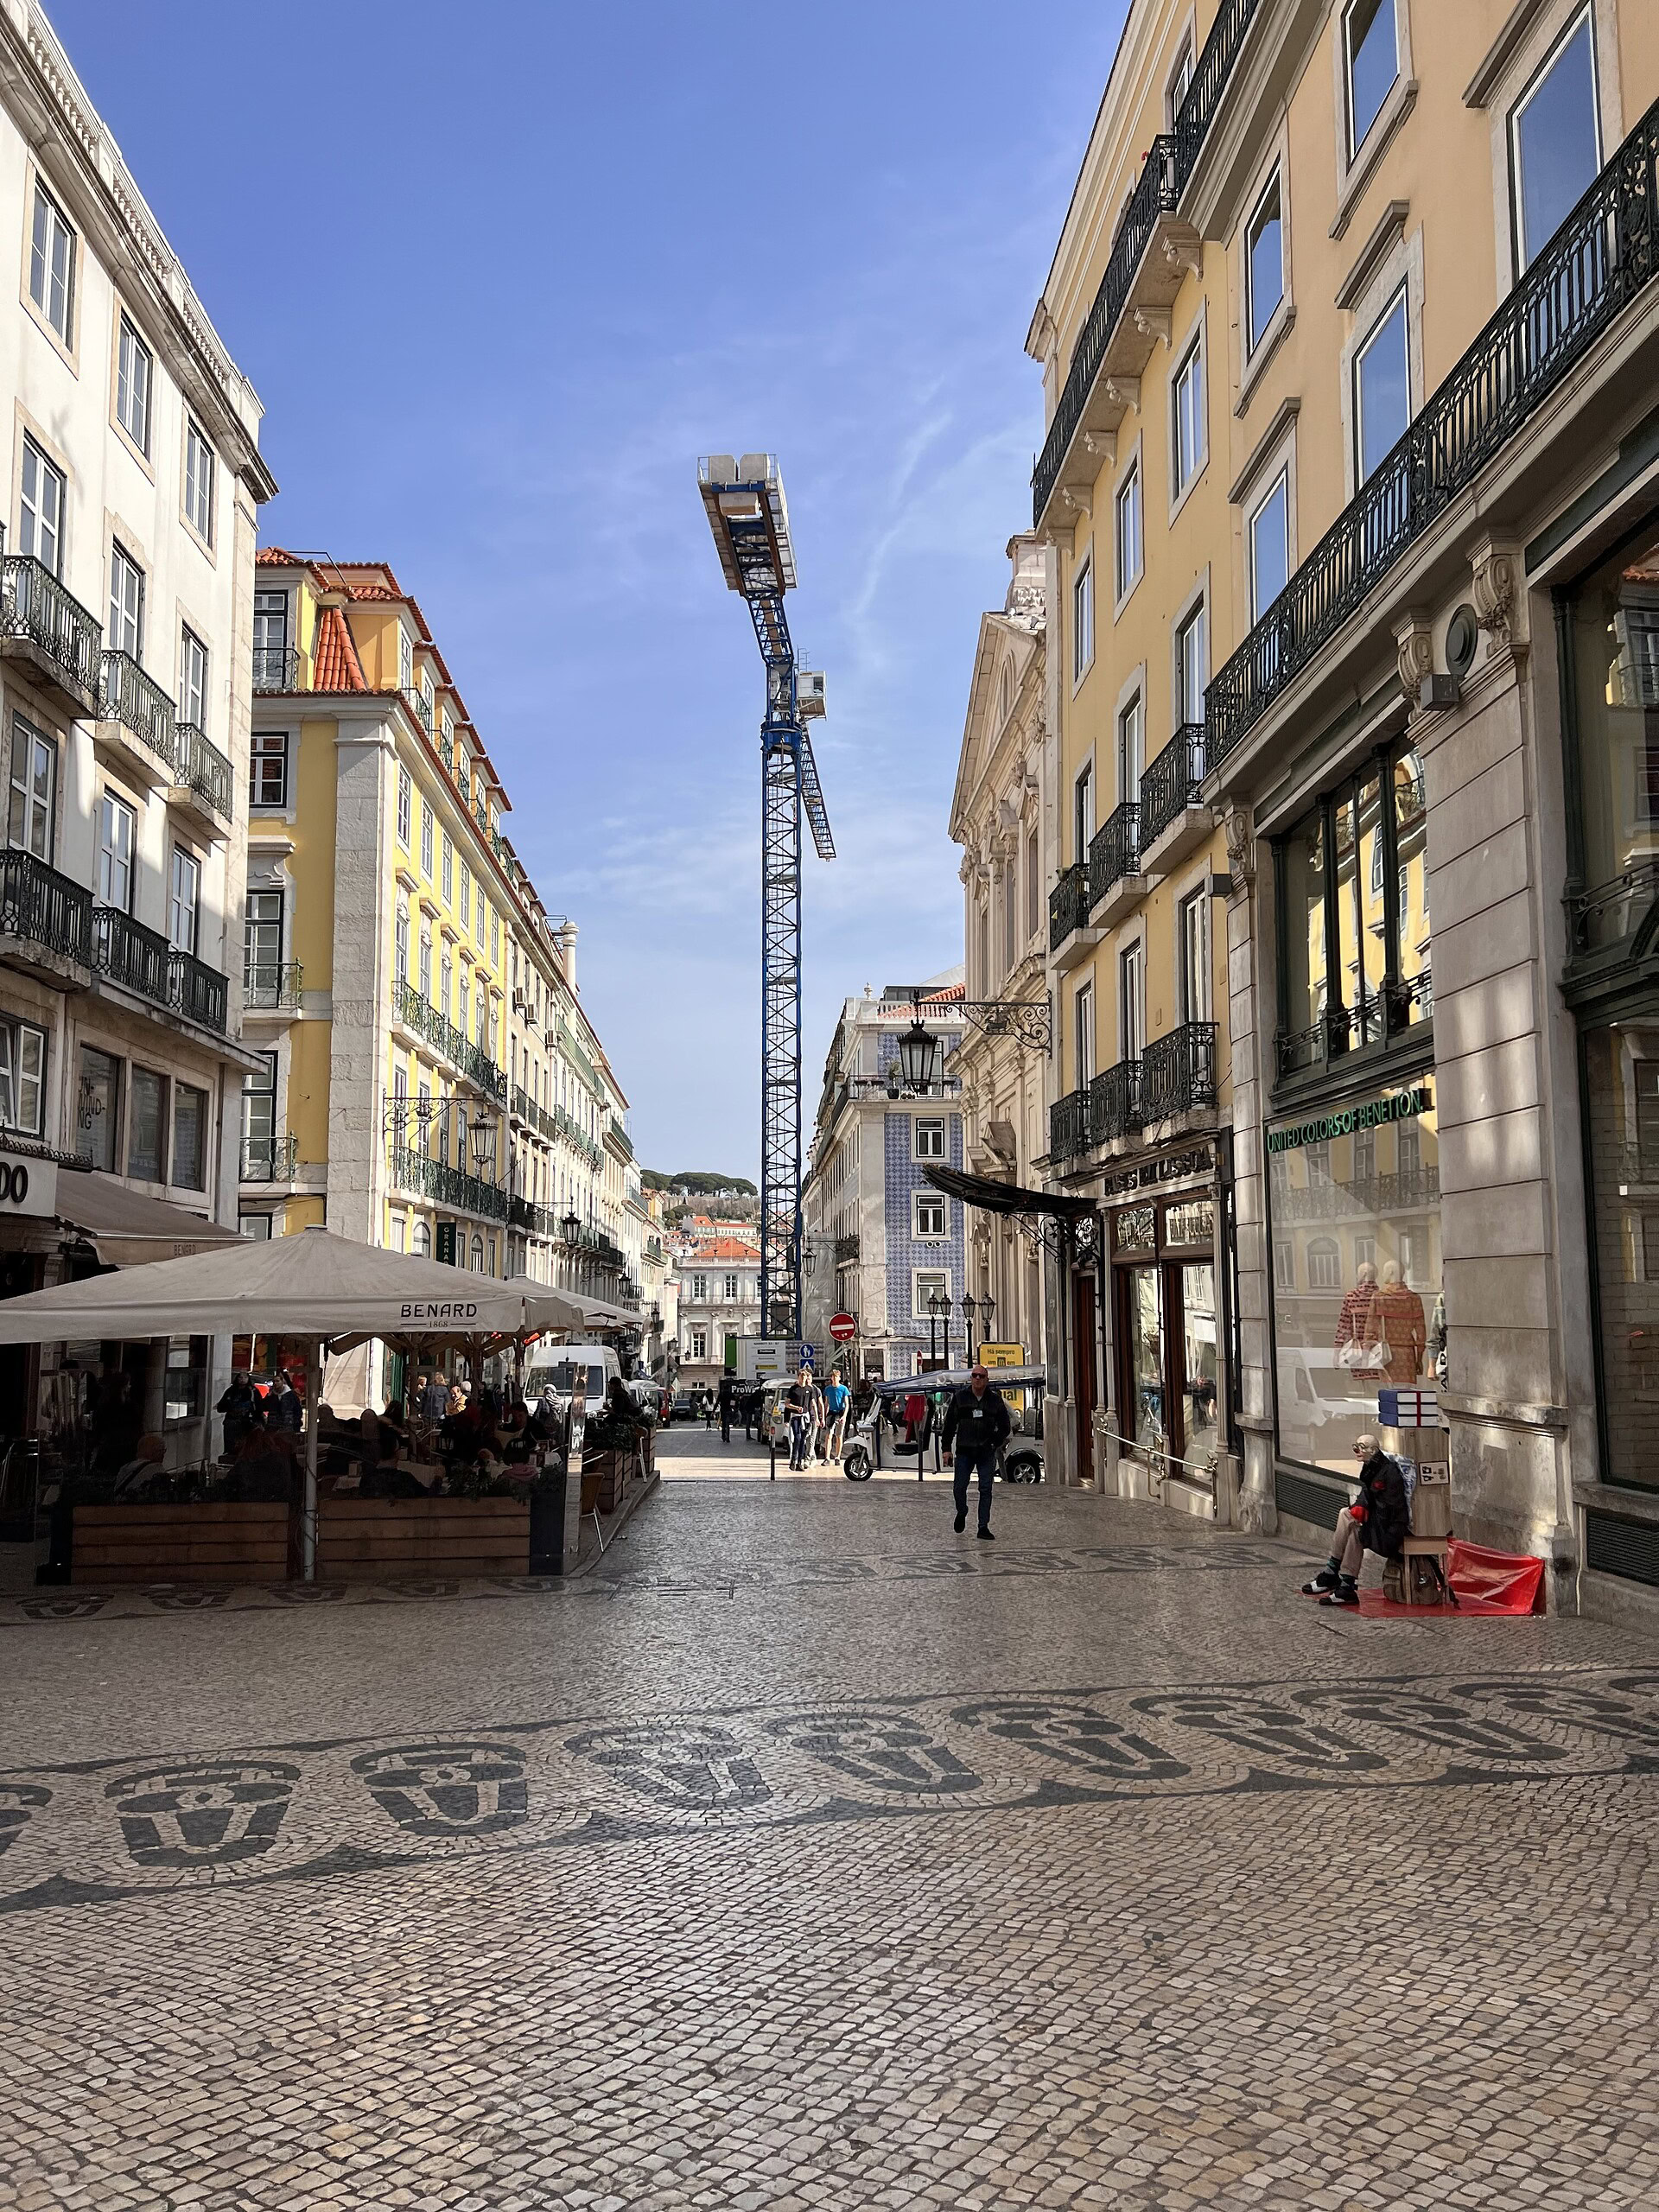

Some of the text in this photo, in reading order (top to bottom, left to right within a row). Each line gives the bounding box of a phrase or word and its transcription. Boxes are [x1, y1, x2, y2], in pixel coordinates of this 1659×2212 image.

[1267, 1127, 1299, 1154] UNITED
[1301, 1115, 1340, 1144] COLORS
[1342, 1108, 1357, 1134] OF
[401, 1303, 477, 1318] BENARD
